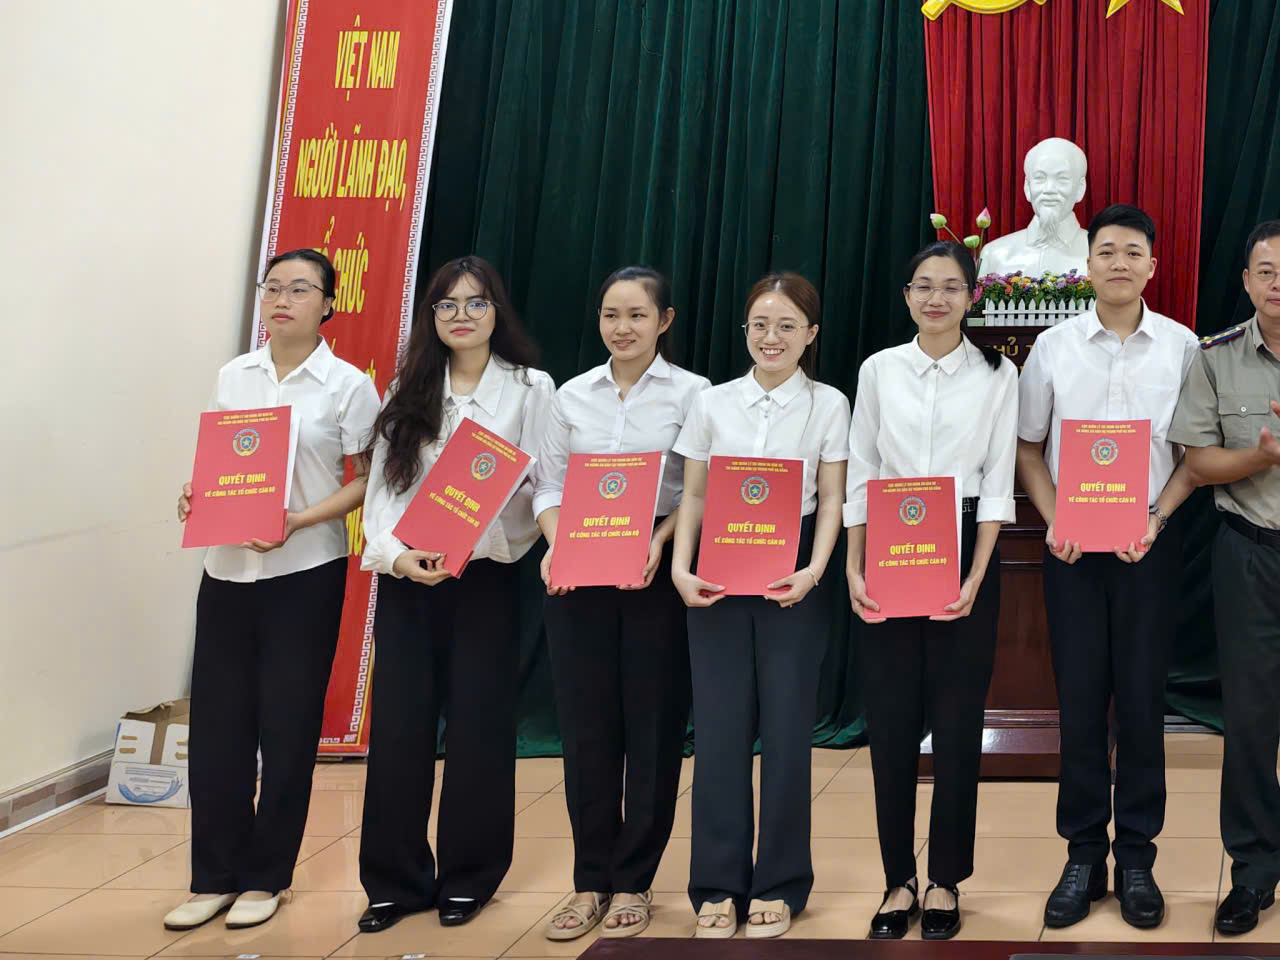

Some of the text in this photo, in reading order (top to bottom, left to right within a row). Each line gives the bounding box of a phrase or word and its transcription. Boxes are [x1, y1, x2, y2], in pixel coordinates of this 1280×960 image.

[334, 15, 401, 101] VIỆT NAM
[293, 122, 408, 212] NGƯỜI LÃNH ĐẠO,
[219, 472, 244, 486] QUYẾT
[1080, 482, 1105, 492] QUYẾT
[583, 515, 608, 527] QUYẾT
[728, 521, 753, 533] QUYẾT
[890, 543, 914, 555] QUYẾT
